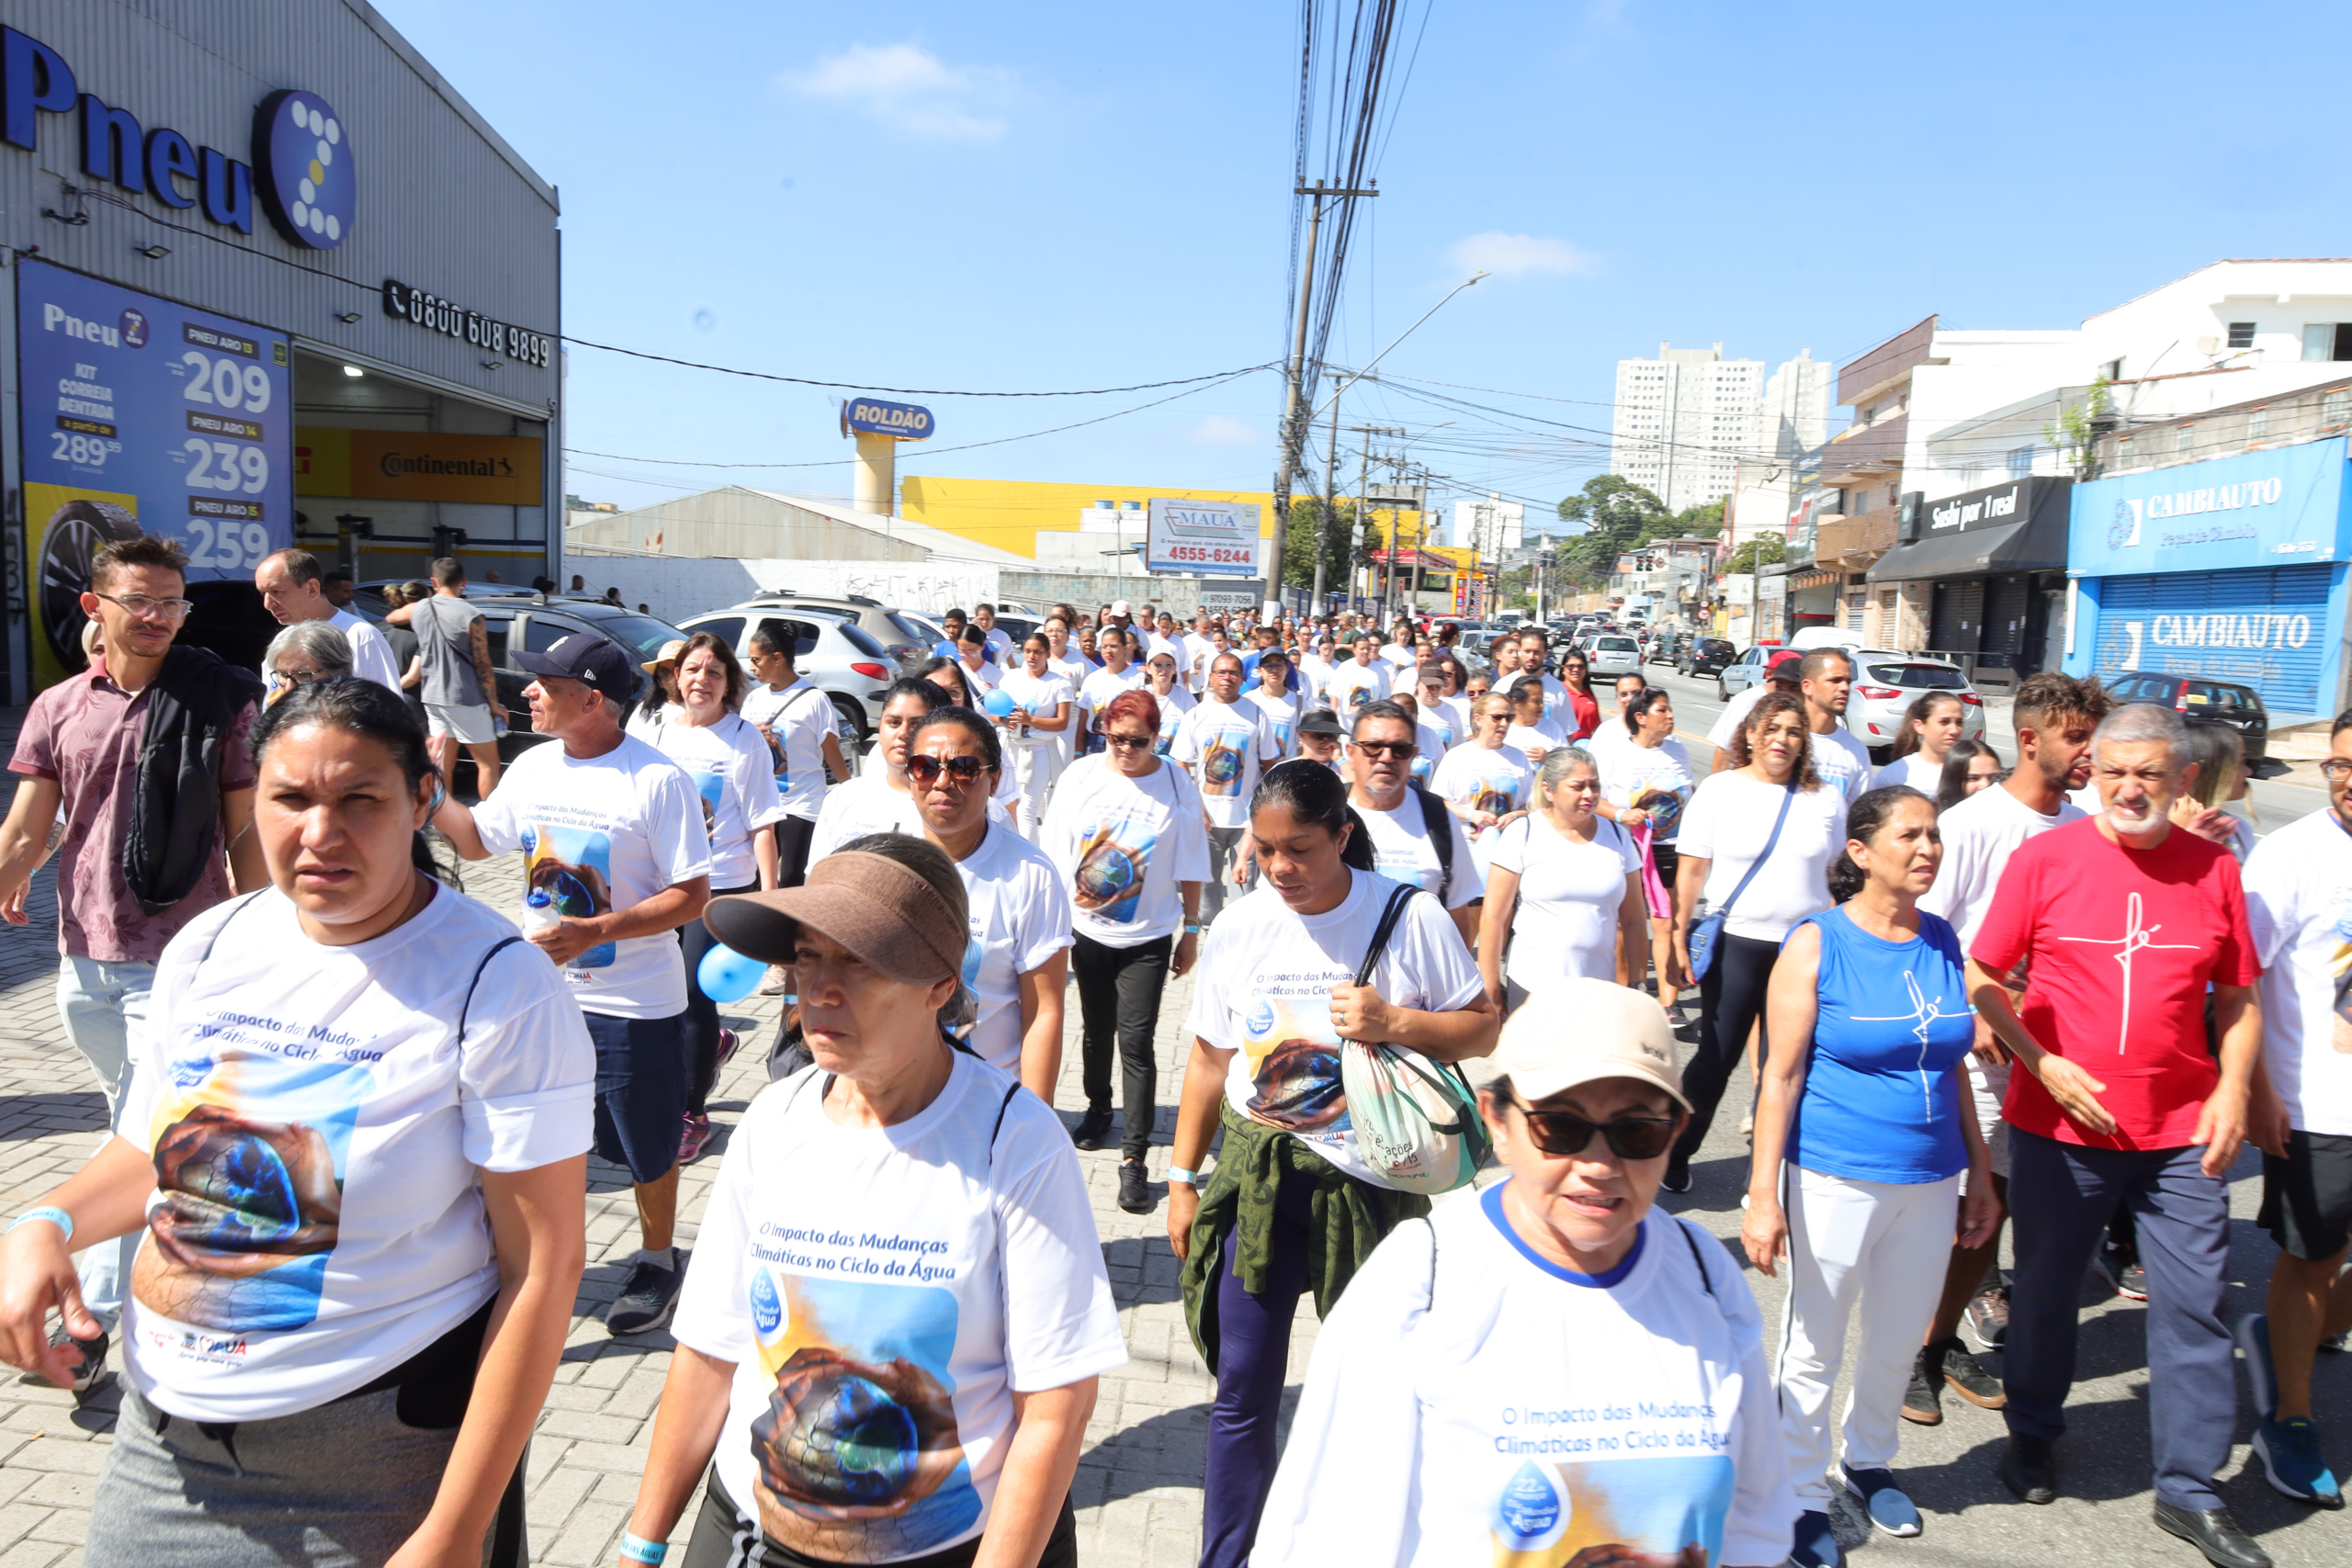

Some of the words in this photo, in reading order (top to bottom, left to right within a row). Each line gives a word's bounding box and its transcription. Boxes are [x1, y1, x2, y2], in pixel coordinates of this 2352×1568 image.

[1, 23, 253, 236] Pneu
[44, 302, 119, 348] Pneu
[410, 288, 461, 337] 0800
[468, 310, 503, 352] 608
[508, 327, 549, 367] 9899
[188, 328, 218, 345] PNEU
[219, 336, 242, 351] ARO
[75, 362, 97, 380] KIT
[182, 351, 271, 413] 209
[58, 378, 113, 402] CORREIA
[57, 396, 115, 421] DENTADA
[854, 404, 928, 430] ROLDÃO
[192, 416, 221, 431] PNEU
[222, 422, 245, 434] ARO
[245, 425, 258, 436] 14
[50, 432, 107, 466] 289
[183, 438, 269, 494] 239
[379, 451, 496, 478] Continental
[194, 501, 223, 513] PNEU
[224, 504, 247, 515] ARO
[248, 506, 259, 516] 15
[1931, 500, 1962, 529] Sushi
[1959, 502, 1983, 531] por
[1984, 495, 1992, 519] 1
[1991, 486, 2018, 517] real
[2147, 478, 2282, 519] CAMBIAUTO
[1180, 512, 1238, 527] MAUÁ
[185, 519, 269, 570] 259
[1170, 547, 1250, 563] 4555-6244
[2152, 615, 2311, 649] CAMBIAUTO
[562, 816, 577, 825] Ciclo
[588, 819, 610, 830] Água
[570, 807, 607, 819] Mudanças
[1256, 975, 1264, 983] O
[1304, 972, 1319, 981] das
[218, 1010, 282, 1032] Impacto
[1250, 1018, 1269, 1032] Água
[760, 1222, 771, 1235] O
[772, 1223, 825, 1243] Impacto
[828, 1230, 855, 1247] das
[859, 1233, 949, 1256] Mudanças
[751, 1242, 812, 1268] Climáticas
[816, 1258, 836, 1271] no
[840, 1256, 879, 1275] Ciclo
[883, 1260, 906, 1277] da
[909, 1256, 956, 1281] Água
[755, 1279, 766, 1292] 22
[755, 1305, 776, 1329] Água
[1502, 1407, 1517, 1425] O
[1524, 1406, 1597, 1427] Impacto
[1602, 1404, 1633, 1421] das
[1495, 1434, 1592, 1454] Climáticas
[1598, 1437, 1619, 1450] no
[1625, 1430, 1669, 1449] Ciclo
[1675, 1429, 1696, 1447] da
[1516, 1478, 1538, 1491] 22
[1510, 1510, 1553, 1532] Água
